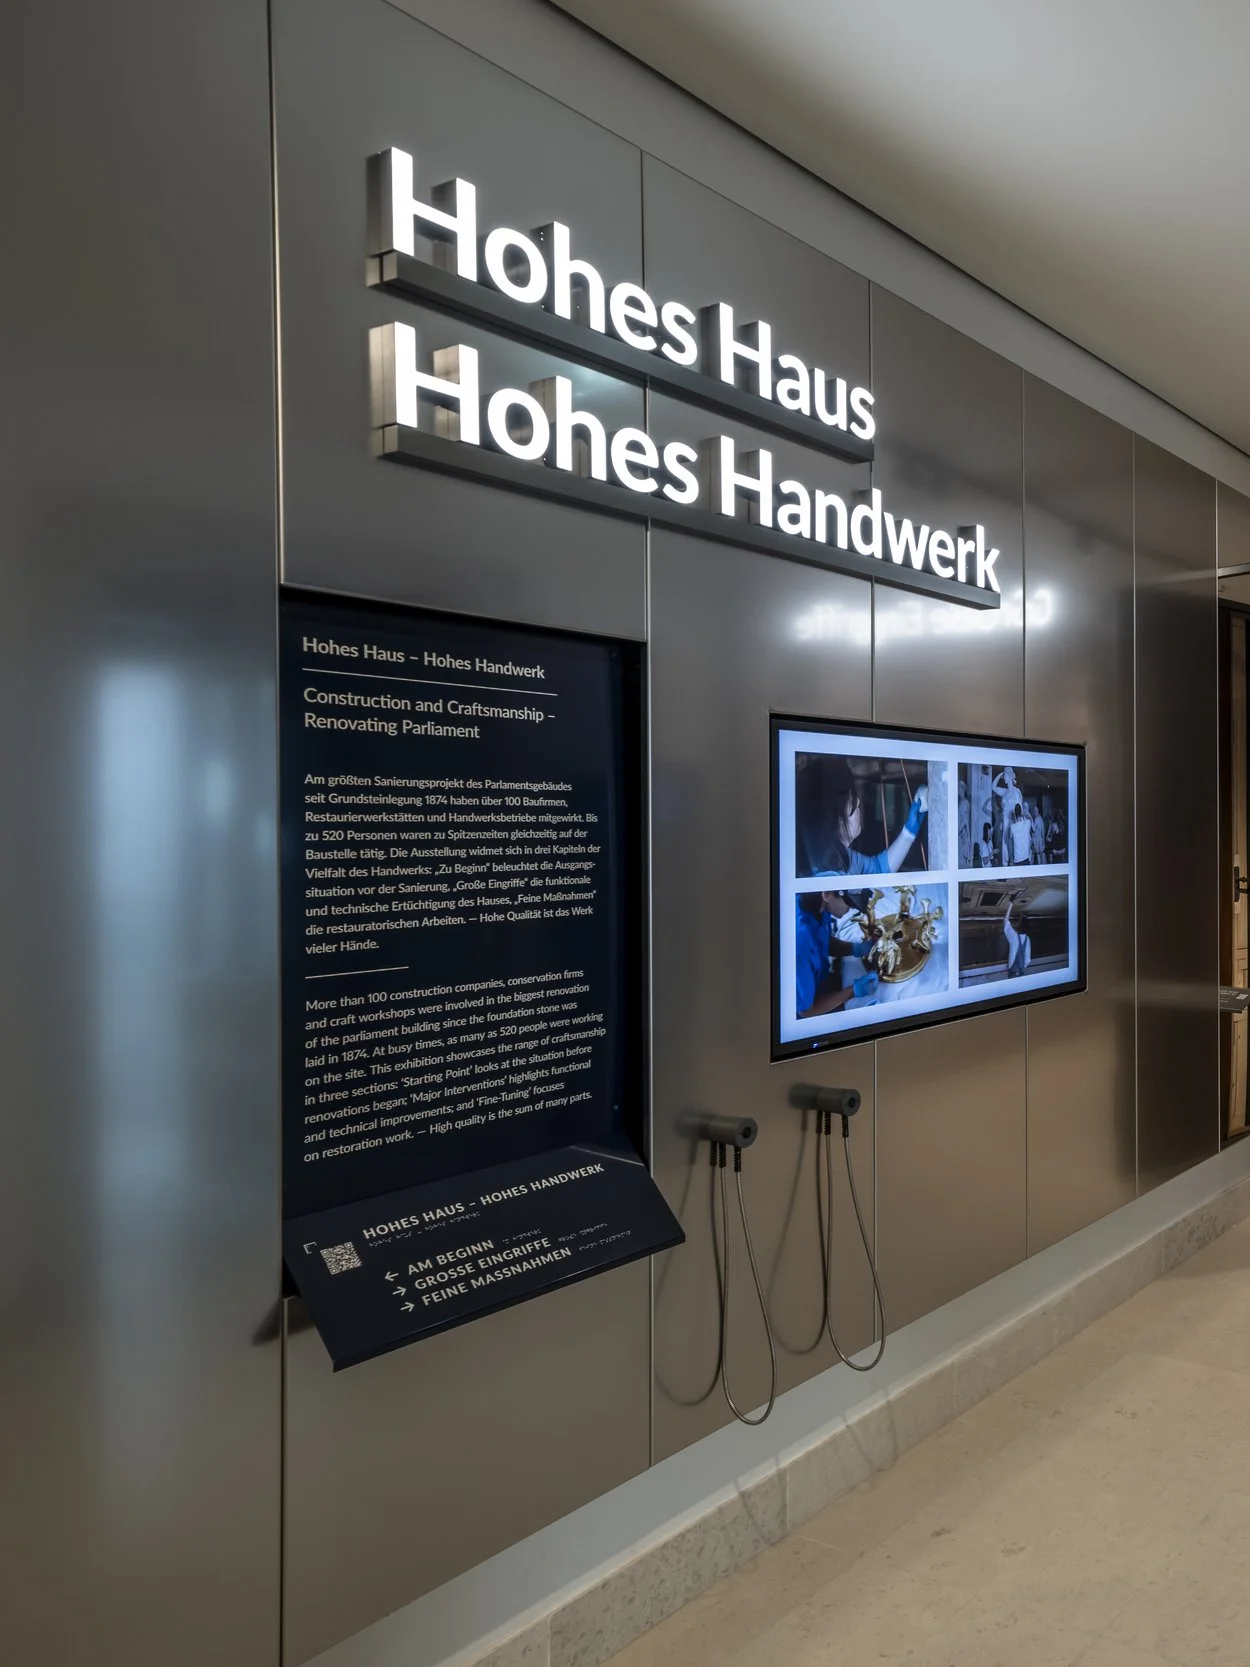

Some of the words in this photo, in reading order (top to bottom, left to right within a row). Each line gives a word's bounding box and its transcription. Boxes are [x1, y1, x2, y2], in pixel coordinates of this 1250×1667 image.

[391, 147, 698, 367] Hohes
[719, 302, 875, 440] Haus
[394, 322, 699, 504] Hohes
[720, 435, 1000, 591] Handwerk
[302, 637, 359, 657] Hohes
[364, 644, 405, 663] Haus
[424, 652, 471, 670] Hohes
[475, 658, 546, 679] Handwerk
[303, 687, 411, 710] Construction
[415, 699, 443, 713] and
[447, 700, 544, 723] Craftsmanship
[304, 713, 397, 735] Renovating
[402, 720, 480, 738] Parliament
[304, 774, 325, 784] Am
[328, 775, 371, 787] größten
[374, 776, 464, 789] Sanierungsprojekt
[466, 779, 482, 788] des
[485, 780, 572, 792] Parlamentsgebäudes
[305, 793, 326, 803] seit
[328, 793, 422, 806] Grundsteinlegung
[424, 795, 448, 805] 1874
[450, 796, 479, 805] haben
[482, 796, 502, 806] über
[505, 797, 520, 806] 100
[523, 797, 568, 807] Baufirmen,
[305, 812, 424, 822] Restaurierwerkstätten
[427, 813, 446, 822] und
[449, 813, 536, 822] Handwerksbetriebe
[539, 814, 584, 824] mitgewirkt.
[586, 814, 598, 822] Bis
[322, 831, 344, 840] 520
[347, 831, 397, 840] Personen
[400, 832, 431, 840] waren
[448, 830, 508, 840] Spitzenzeiten
[511, 829, 557, 840] gleichzeitig
[559, 829, 572, 838] auf
[574, 829, 588, 838] der
[305, 867, 346, 878] Vielfalt
[349, 867, 368, 877] des
[371, 866, 432, 876] Handwerks:
[492, 862, 538, 872] beleuchtet
[540, 861, 553, 870] die
[555, 861, 596, 871] Ausgangs-
[306, 849, 357, 860] Baustelle
[360, 848, 387, 860] tätig.
[390, 848, 408, 858] Die
[410, 846, 467, 858] Ausstellung
[469, 846, 503, 856] widmet
[506, 846, 522, 855] sich
[524, 846, 532, 854] in
[535, 845, 551, 854] drei
[553, 845, 586, 855] Kapiteln
[588, 844, 600, 853] der
[306, 886, 354, 898] situation
[358, 886, 375, 894] vor
[378, 884, 396, 894] der
[530, 878, 543, 886] die
[546, 876, 591, 886] funktionale
[306, 905, 328, 916] und
[331, 902, 389, 915] technische
[392, 900, 456, 911] Ertüchtigung
[458, 898, 475, 907] des
[477, 896, 512, 906] Hauses,
[306, 925, 323, 935] die
[326, 919, 419, 934] restauratorischen
[421, 914, 466, 927] Arbeiten.
[480, 912, 504, 922] Hohe
[507, 910, 541, 921] Qualität
[544, 909, 553, 917] ist
[556, 908, 569, 916] das
[571, 906, 594, 915] Werk
[306, 943, 337, 954] vieler
[340, 940, 379, 952] Hände.
[306, 1000, 336, 1011] More
[340, 996, 364, 1007] than
[368, 992, 387, 1003] 100
[390, 985, 452, 1001] construction
[455, 979, 505, 993] companies,
[508, 972, 561, 986] conservation
[564, 970, 584, 979] firms
[306, 1018, 326, 1030] and
[330, 1014, 356, 1026] craft
[359, 1007, 415, 1022] workshops
[418, 1004, 442, 1014] were
[445, 998, 484, 1011] involved
[497, 994, 512, 1004] the
[514, 990, 544, 1002] biggest
[547, 984, 589, 997] renovation
[305, 1055, 325, 1068] laid
[342, 1048, 370, 1062] 1874.
[372, 1046, 385, 1057] At
[388, 1044, 412, 1054] busy
[415, 1039, 444, 1050] times,
[460, 1032, 485, 1043] many
[500, 1025, 516, 1036] 520
[519, 1021, 547, 1034] people
[550, 1018, 570, 1028] were
[572, 1013, 603, 1024] working
[321, 1036, 339, 1046] the
[343, 1026, 399, 1045] parliament
[402, 1021, 440, 1035] building
[442, 1017, 467, 1028] since
[470, 1014, 485, 1024] the
[487, 1008, 534, 1022] foundation
[537, 1004, 559, 1014] stone
[562, 1002, 578, 1010] was
[319, 1090, 348, 1103] three
[352, 1082, 398, 1097] sections:
[475, 1062, 499, 1073] looks
[512, 1057, 527, 1067] the
[529, 1051, 564, 1063] situation
[566, 1045, 592, 1057] before
[323, 1073, 342, 1083] the
[345, 1068, 366, 1080] site.
[370, 1063, 392, 1075] This
[394, 1055, 444, 1070] exhibition
[446, 1046, 495, 1062] showcases
[498, 1044, 512, 1053] the
[515, 1041, 539, 1052] range
[552, 1029, 606, 1044] craftsmanship
[304, 1105, 370, 1124] renovations
[509, 1070, 549, 1084] highlights
[551, 1060, 591, 1075] functional
[304, 1130, 326, 1143] and
[329, 1119, 377, 1138] technical
[457, 1099, 474, 1111] and
[534, 1082, 565, 1094] focuses
[322, 1138, 382, 1158] restoration
[385, 1130, 414, 1144] work.
[430, 1121, 452, 1134] High
[455, 1115, 486, 1129] quality
[498, 1109, 513, 1119] the
[515, 1105, 532, 1115] sum
[546, 1097, 568, 1108] many
[570, 1091, 592, 1104] parts.
[362, 1215, 419, 1239] HOHES
[423, 1202, 465, 1223] HAUS
[480, 1185, 528, 1206] HOHES
[530, 1163, 605, 1191] HANDWERK
[408, 1259, 432, 1275] AM
[437, 1239, 494, 1265] BEGINN
[414, 1266, 475, 1290] GROSSE
[479, 1237, 551, 1269] EINGRIFFE
[422, 1283, 468, 1306] FEINE
[470, 1247, 572, 1289] MASSNAHMEN
